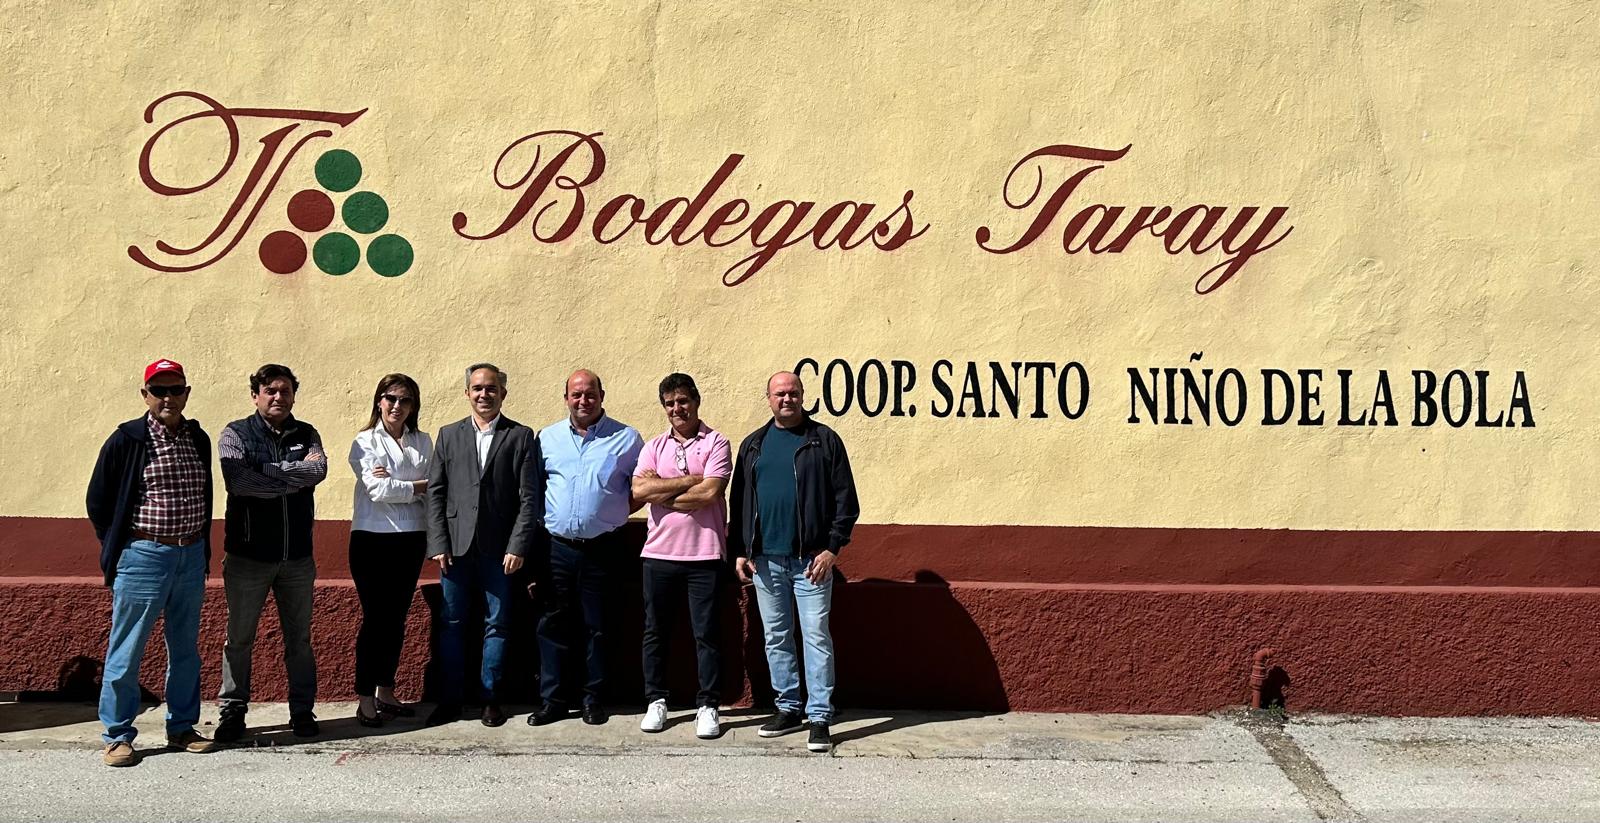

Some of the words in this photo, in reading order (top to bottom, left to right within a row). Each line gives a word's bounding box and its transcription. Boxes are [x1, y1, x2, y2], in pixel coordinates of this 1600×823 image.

[452, 129, 931, 288] Bodegas
[975, 143, 1295, 296] Taray
[931, 359, 1090, 420] SANTO
[1126, 351, 1248, 427] NIÑO
[1260, 368, 1325, 426] DE
[1337, 369, 1399, 427] LA
[1411, 369, 1536, 428] BOLA
